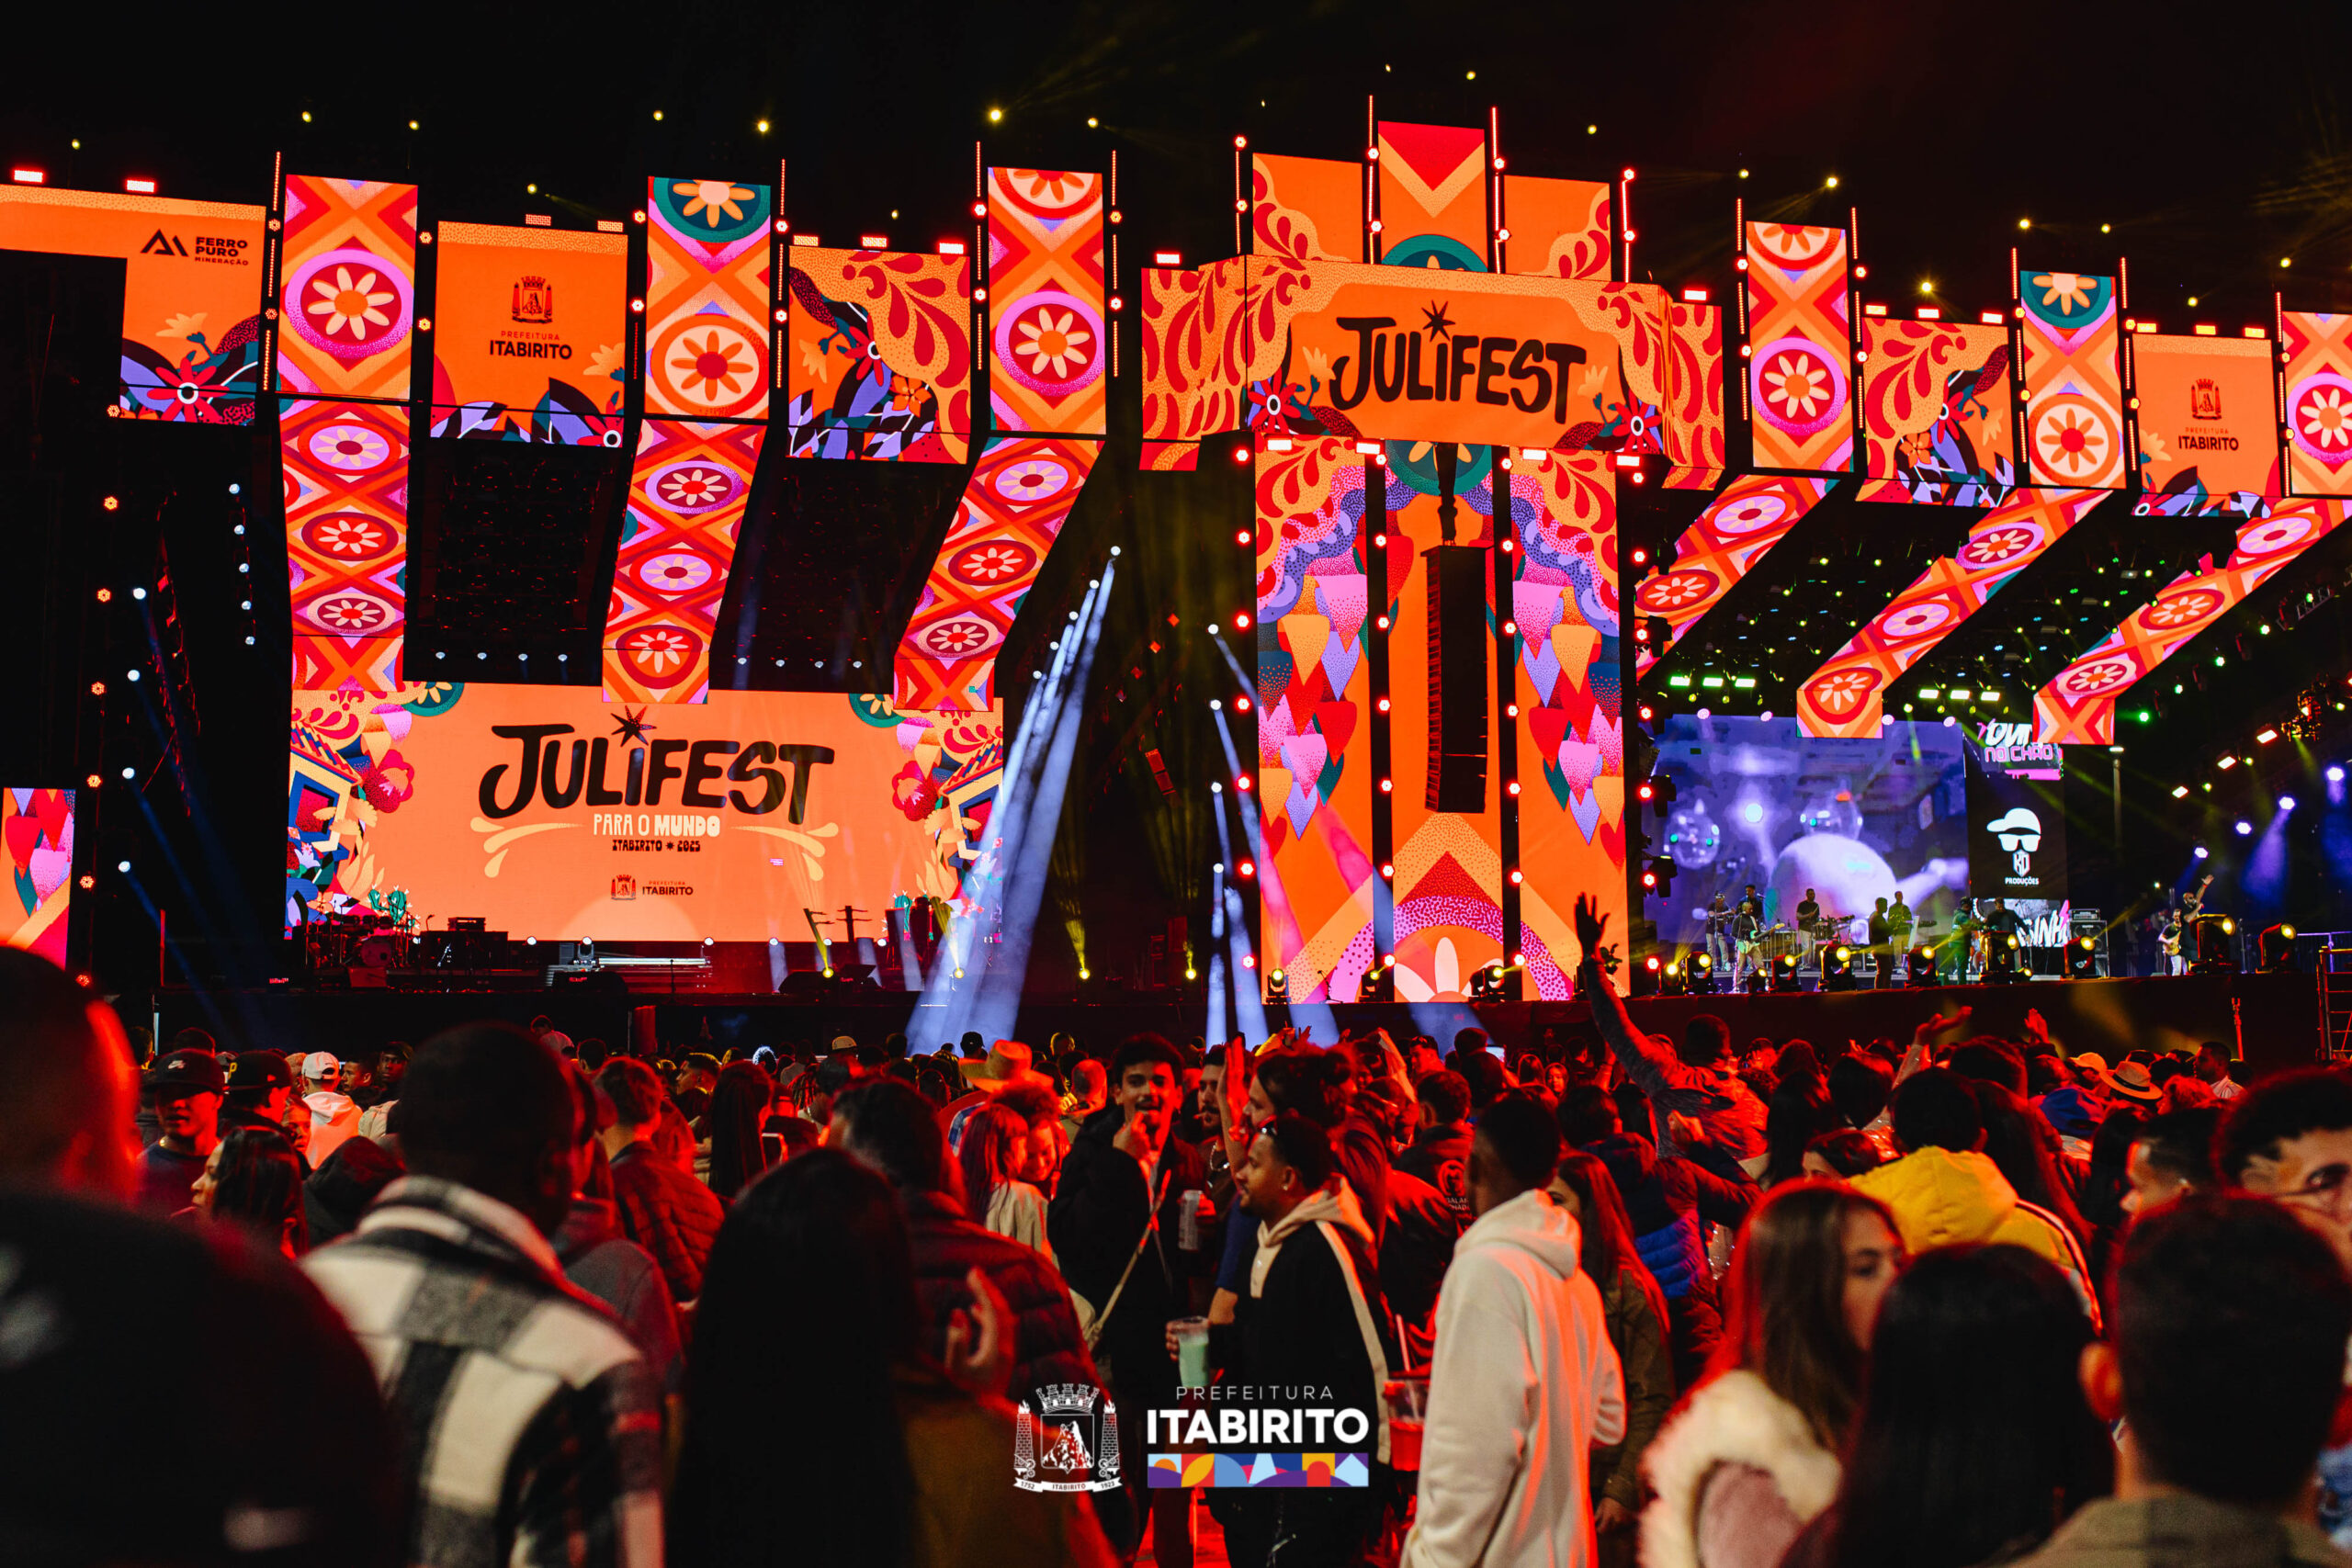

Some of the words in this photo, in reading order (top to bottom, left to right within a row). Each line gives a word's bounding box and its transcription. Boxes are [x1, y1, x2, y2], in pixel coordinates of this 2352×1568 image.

[196, 236, 248, 249] FERRO
[196, 246, 239, 257] PURO
[195, 256, 249, 266] MINERAÇÃO
[501, 331, 560, 341] PREFEITURA
[490, 340, 572, 360] ITABIRITO
[1329, 300, 1587, 424] JULIFEST
[2178, 435, 2239, 451] ITABIRITO
[479, 706, 835, 825] JULIFEST
[594, 813, 633, 836] PARA
[638, 814, 650, 836] O
[654, 814, 720, 838] MUNDO
[612, 839, 662, 852] ITABIRITO
[677, 840, 701, 852] 2025
[2005, 876, 2040, 886] PRODUÇÕES
[642, 886, 694, 896] ITABIRITO
